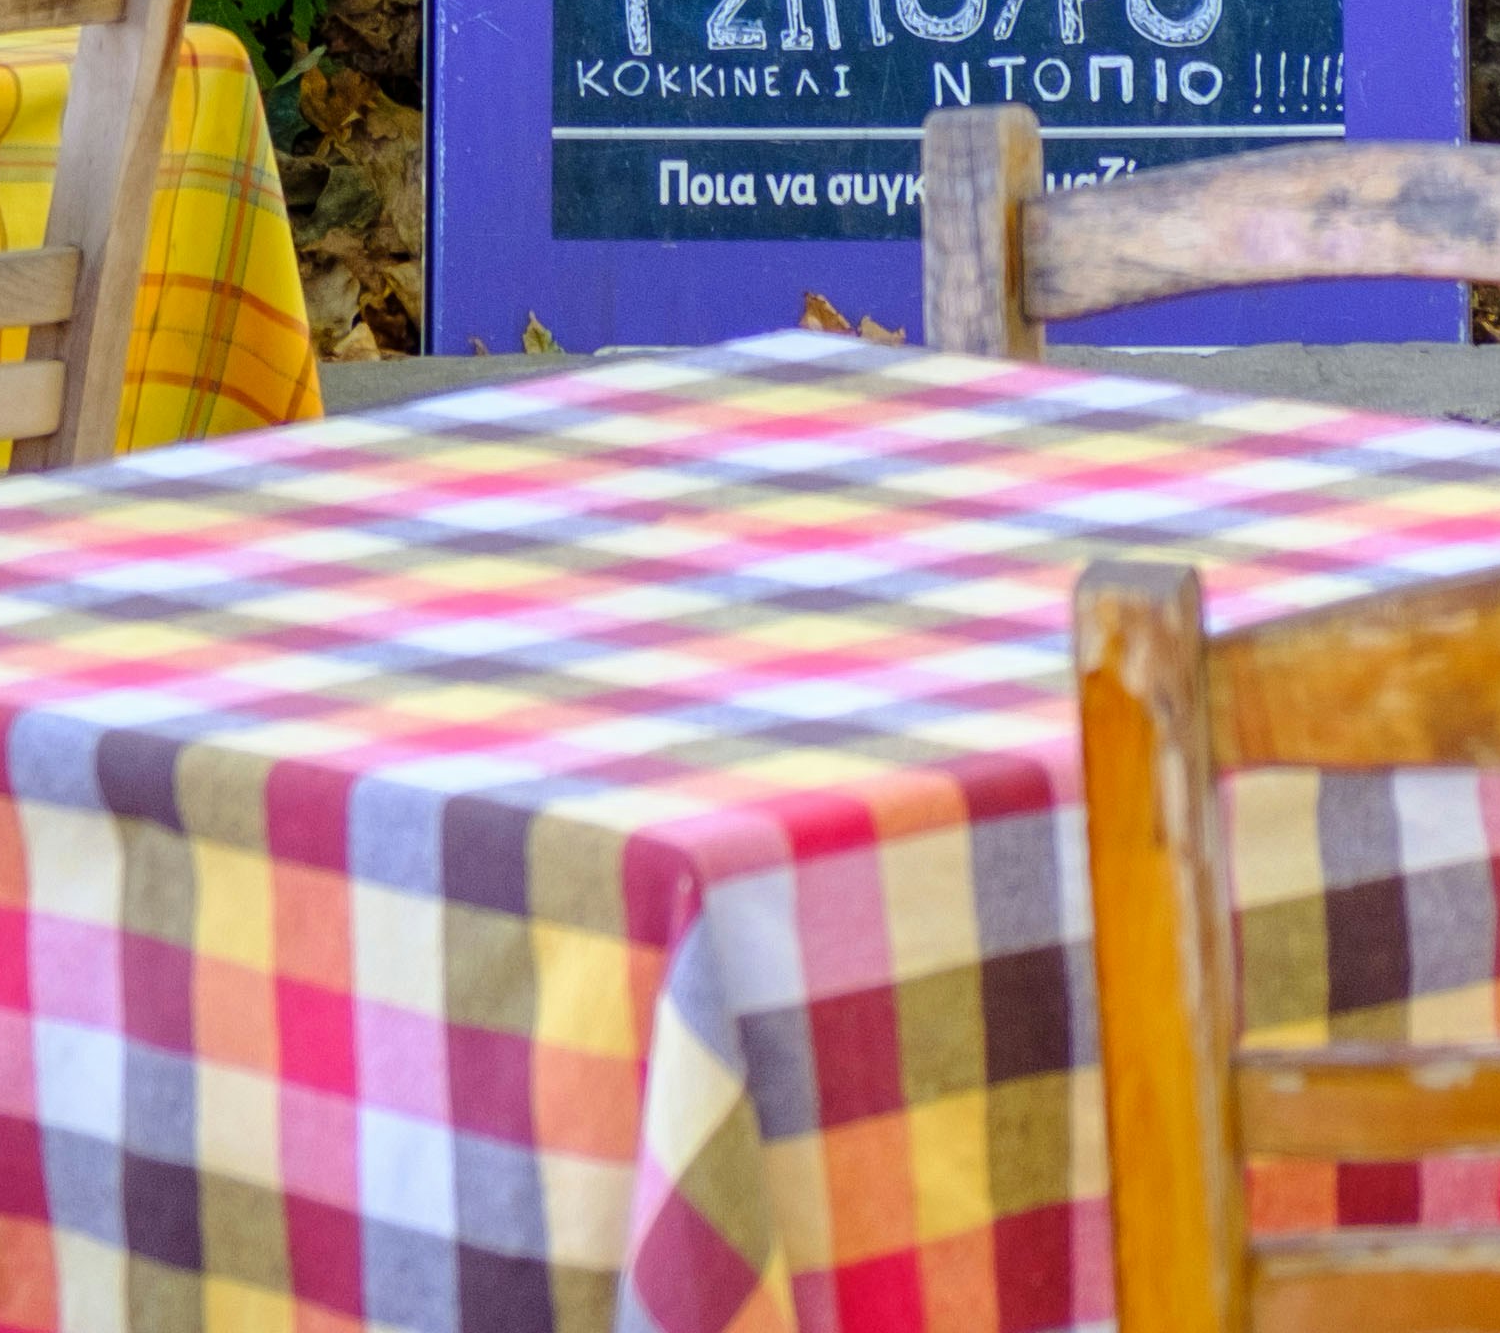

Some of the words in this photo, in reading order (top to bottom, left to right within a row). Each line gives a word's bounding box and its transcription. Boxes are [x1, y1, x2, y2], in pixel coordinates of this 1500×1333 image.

[576, 58, 851, 98] ΚΟΚΚΙΝΕΛΙ
[933, 55, 1223, 106] ΝΤΟΠΙΟ
[659, 159, 756, 206] Ποια
[765, 172, 818, 206] να
[826, 172, 926, 216] συγκ
